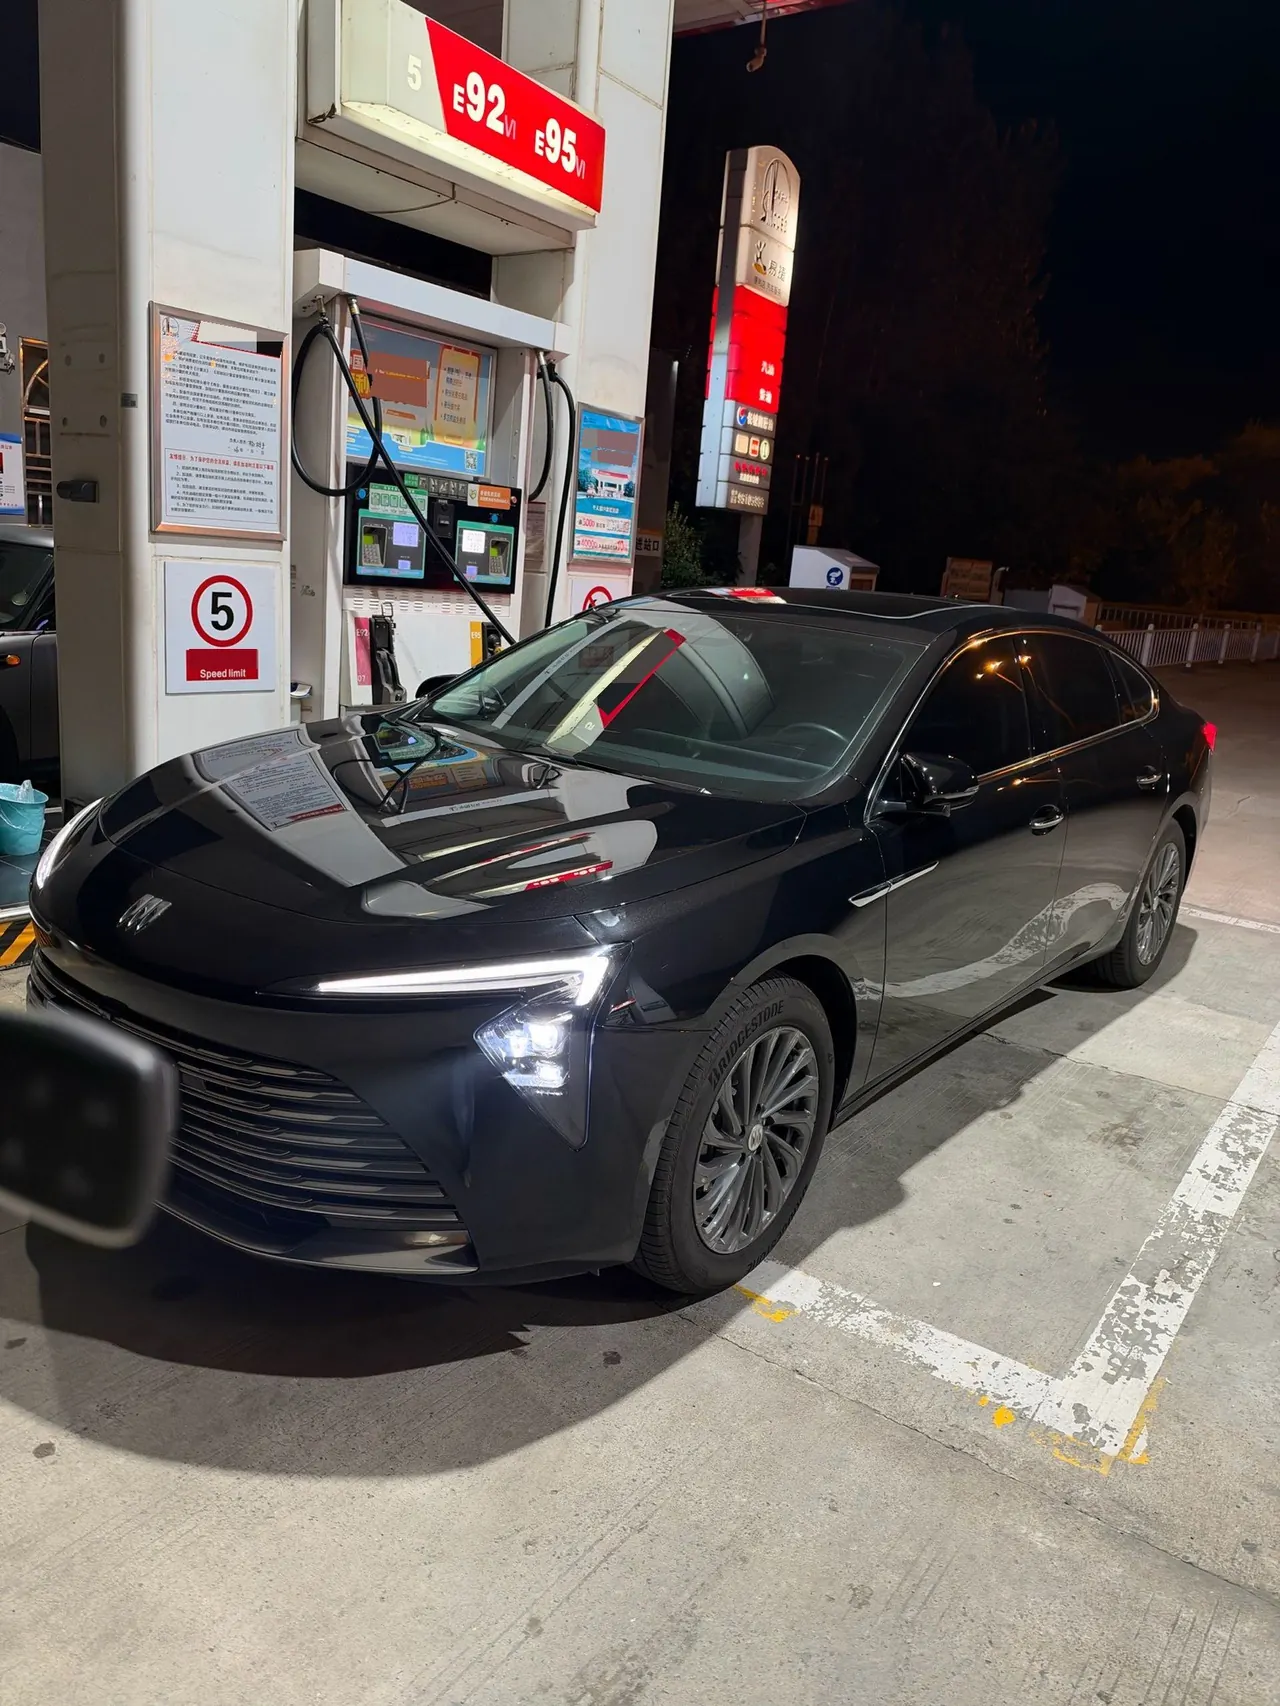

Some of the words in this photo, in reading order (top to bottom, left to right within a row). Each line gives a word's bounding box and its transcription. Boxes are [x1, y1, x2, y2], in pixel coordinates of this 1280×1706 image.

[407, 55, 422, 91] 5
[210, 591, 235, 632] 5
[356, 628, 369, 637] E92
[471, 631, 482, 640] E95
[200, 669, 227, 680] Speed
[228, 669, 247, 678] limit
[707, 999, 785, 1091] BRIDGESTONE
